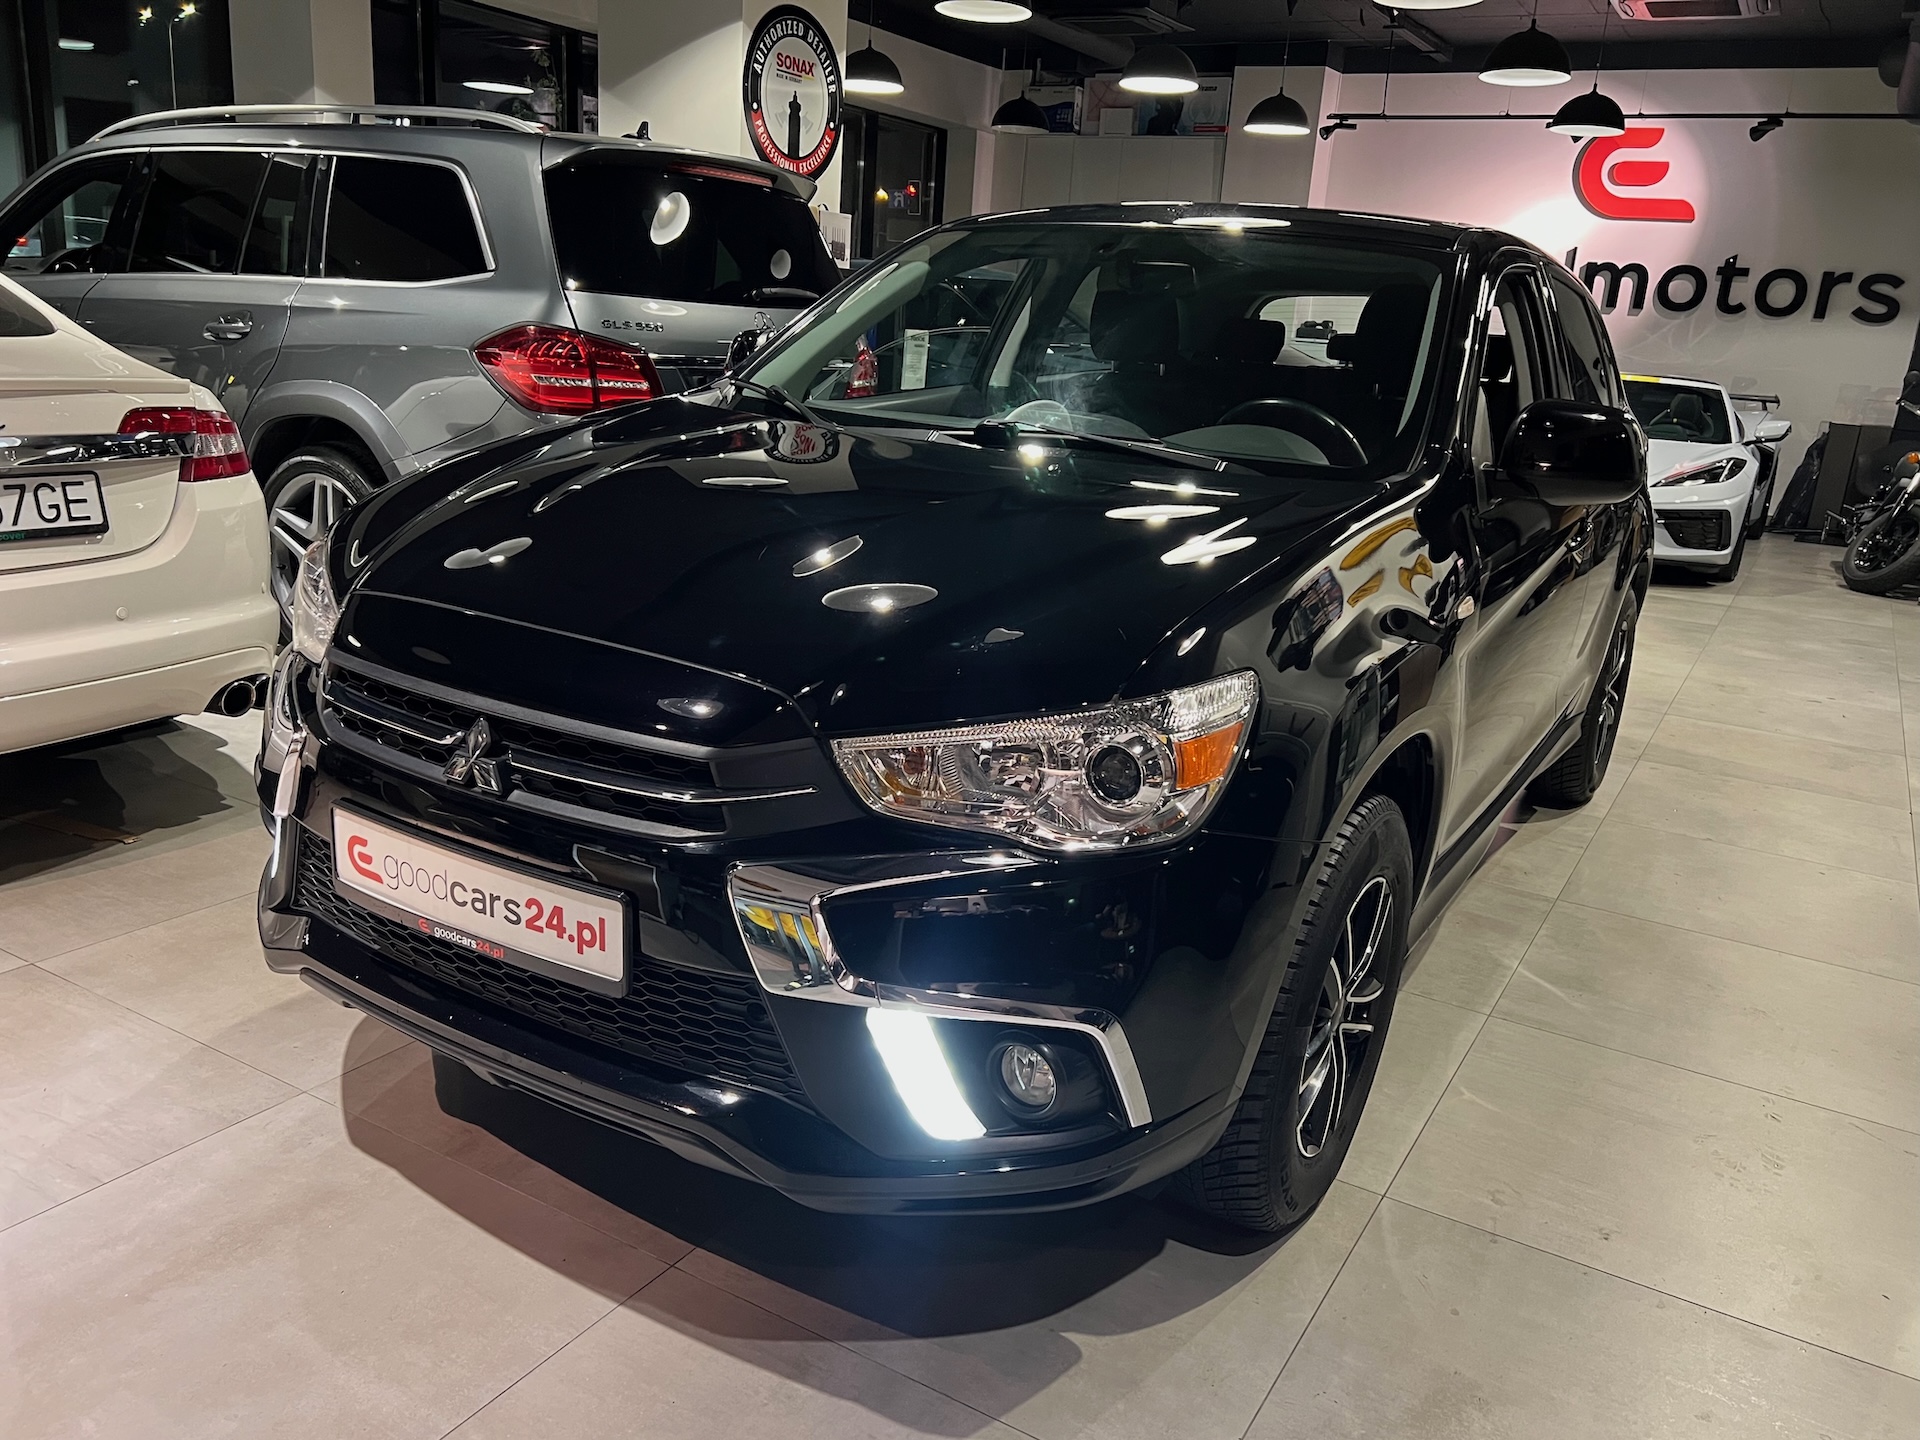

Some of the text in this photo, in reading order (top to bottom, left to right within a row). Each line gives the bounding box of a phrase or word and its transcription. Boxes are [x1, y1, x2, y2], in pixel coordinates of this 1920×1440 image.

[754, 20, 836, 93] AUTHORIZED DETAILER
[776, 52, 815, 77] SONAX
[755, 119, 832, 173] PROFESSIONAL EXCELLENCE
[601, 319, 632, 330] GLS
[0, 481, 91, 526] 7GE
[383, 854, 606, 955] goodcars24.pl
[434, 926, 504, 959] goodcars24.pl
